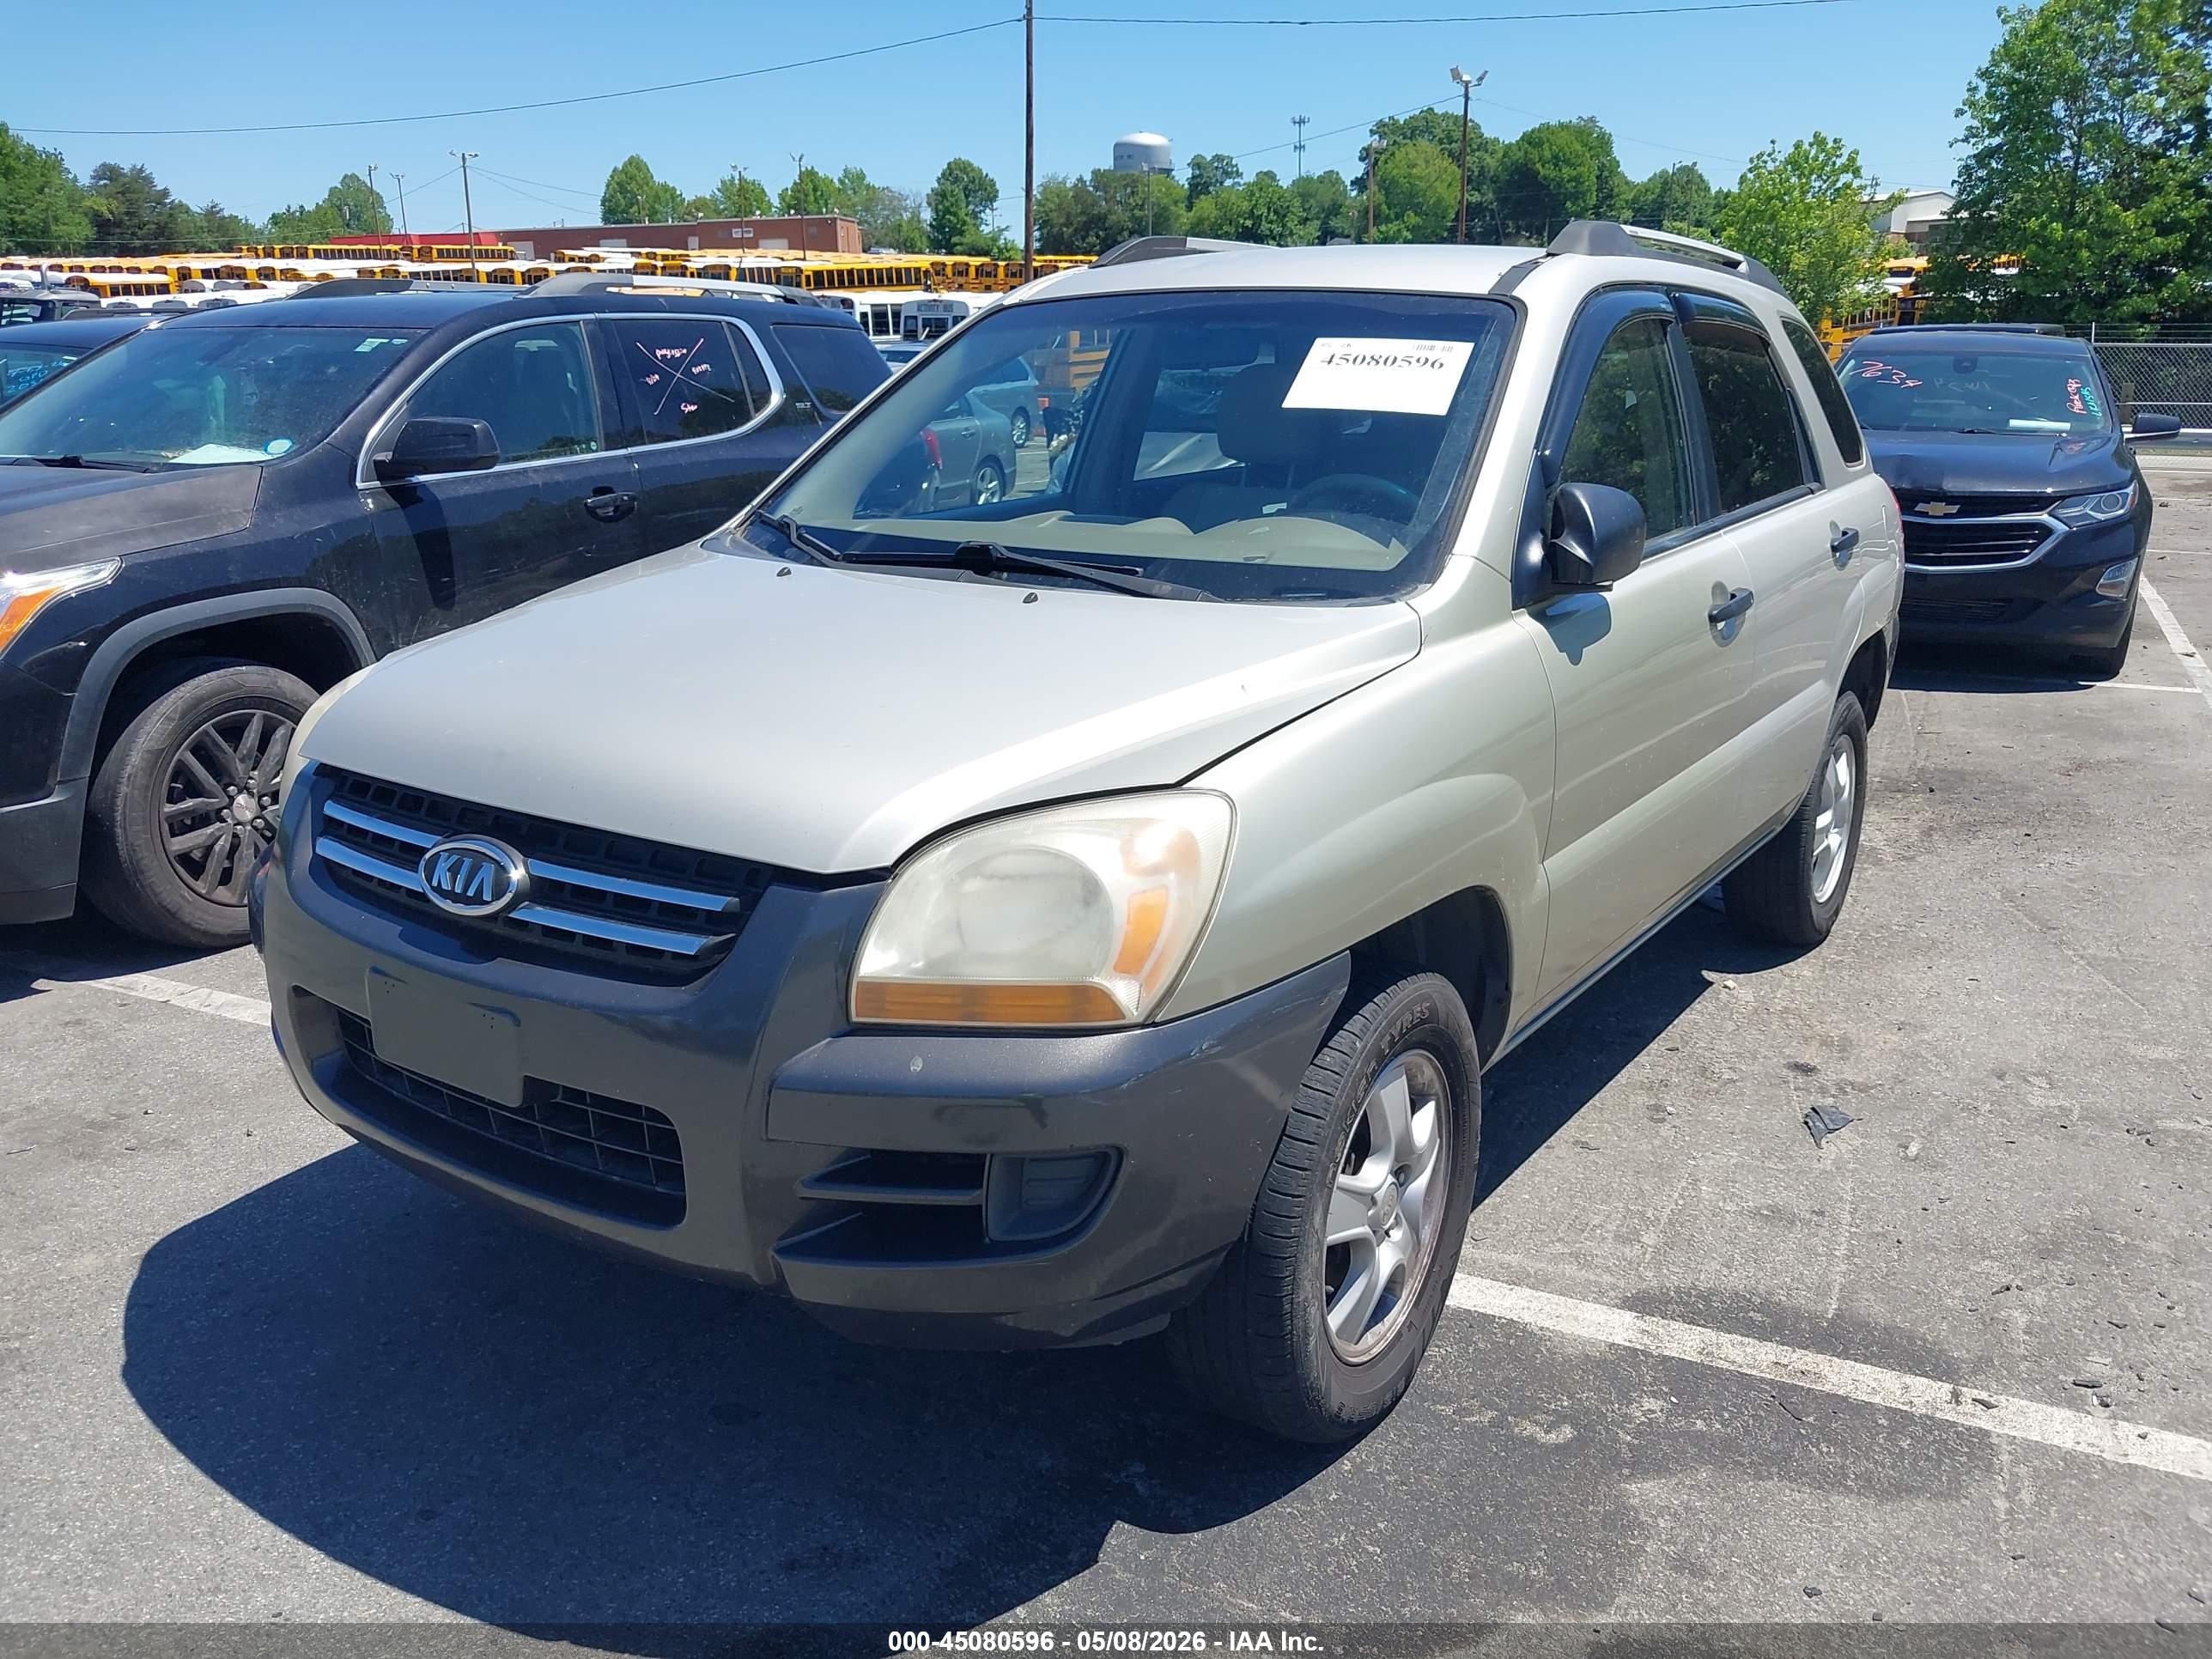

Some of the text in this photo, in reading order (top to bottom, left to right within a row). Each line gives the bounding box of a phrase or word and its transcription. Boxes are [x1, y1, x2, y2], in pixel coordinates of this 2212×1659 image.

[942, 303, 954, 313] BUS
[1320, 353, 1445, 370] 45080596
[1849, 361, 1923, 389] 7634
[431, 851, 495, 902] KIA
[1380, 1001, 1431, 1056] TYRES
